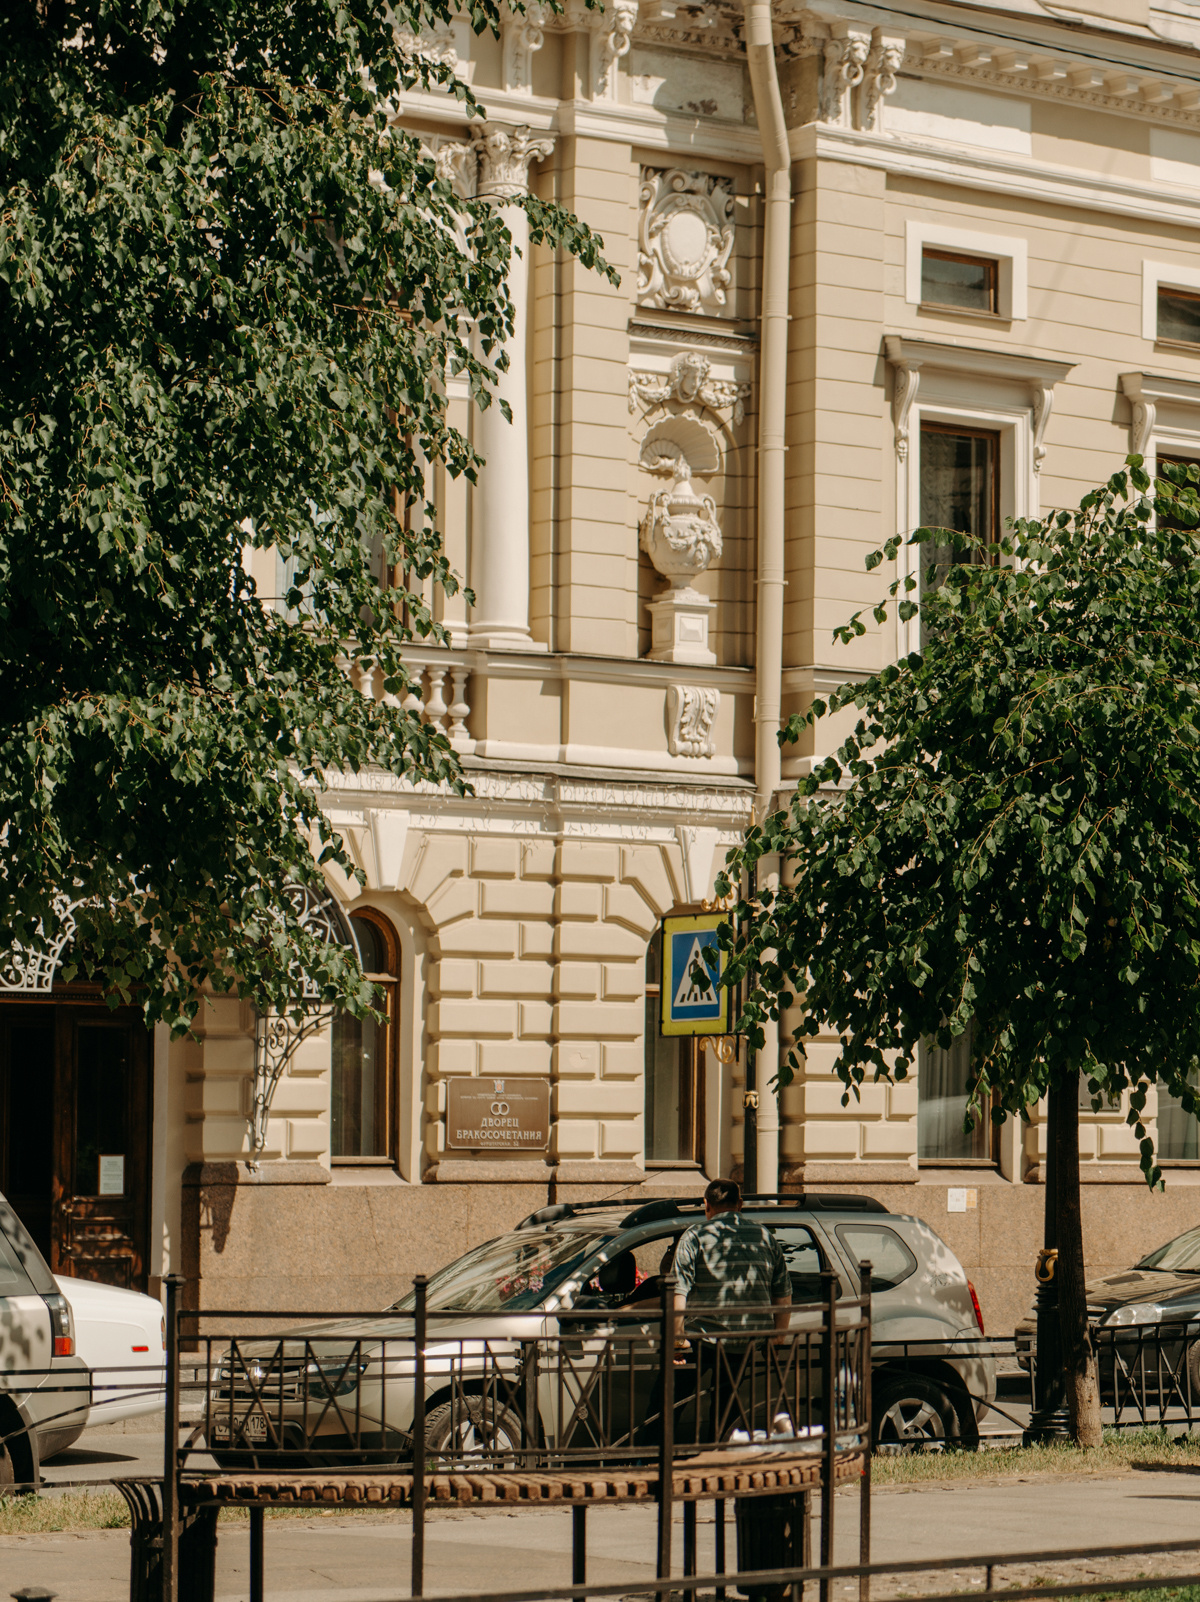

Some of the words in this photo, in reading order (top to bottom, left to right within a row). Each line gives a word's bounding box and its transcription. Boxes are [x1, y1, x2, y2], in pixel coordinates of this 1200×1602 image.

[481, 1117, 519, 1128] ДВОРЕЦ
[456, 1130, 542, 1140] БРАКОСОЧЕТАНИЯ
[251, 1416, 265, 1429] 178
